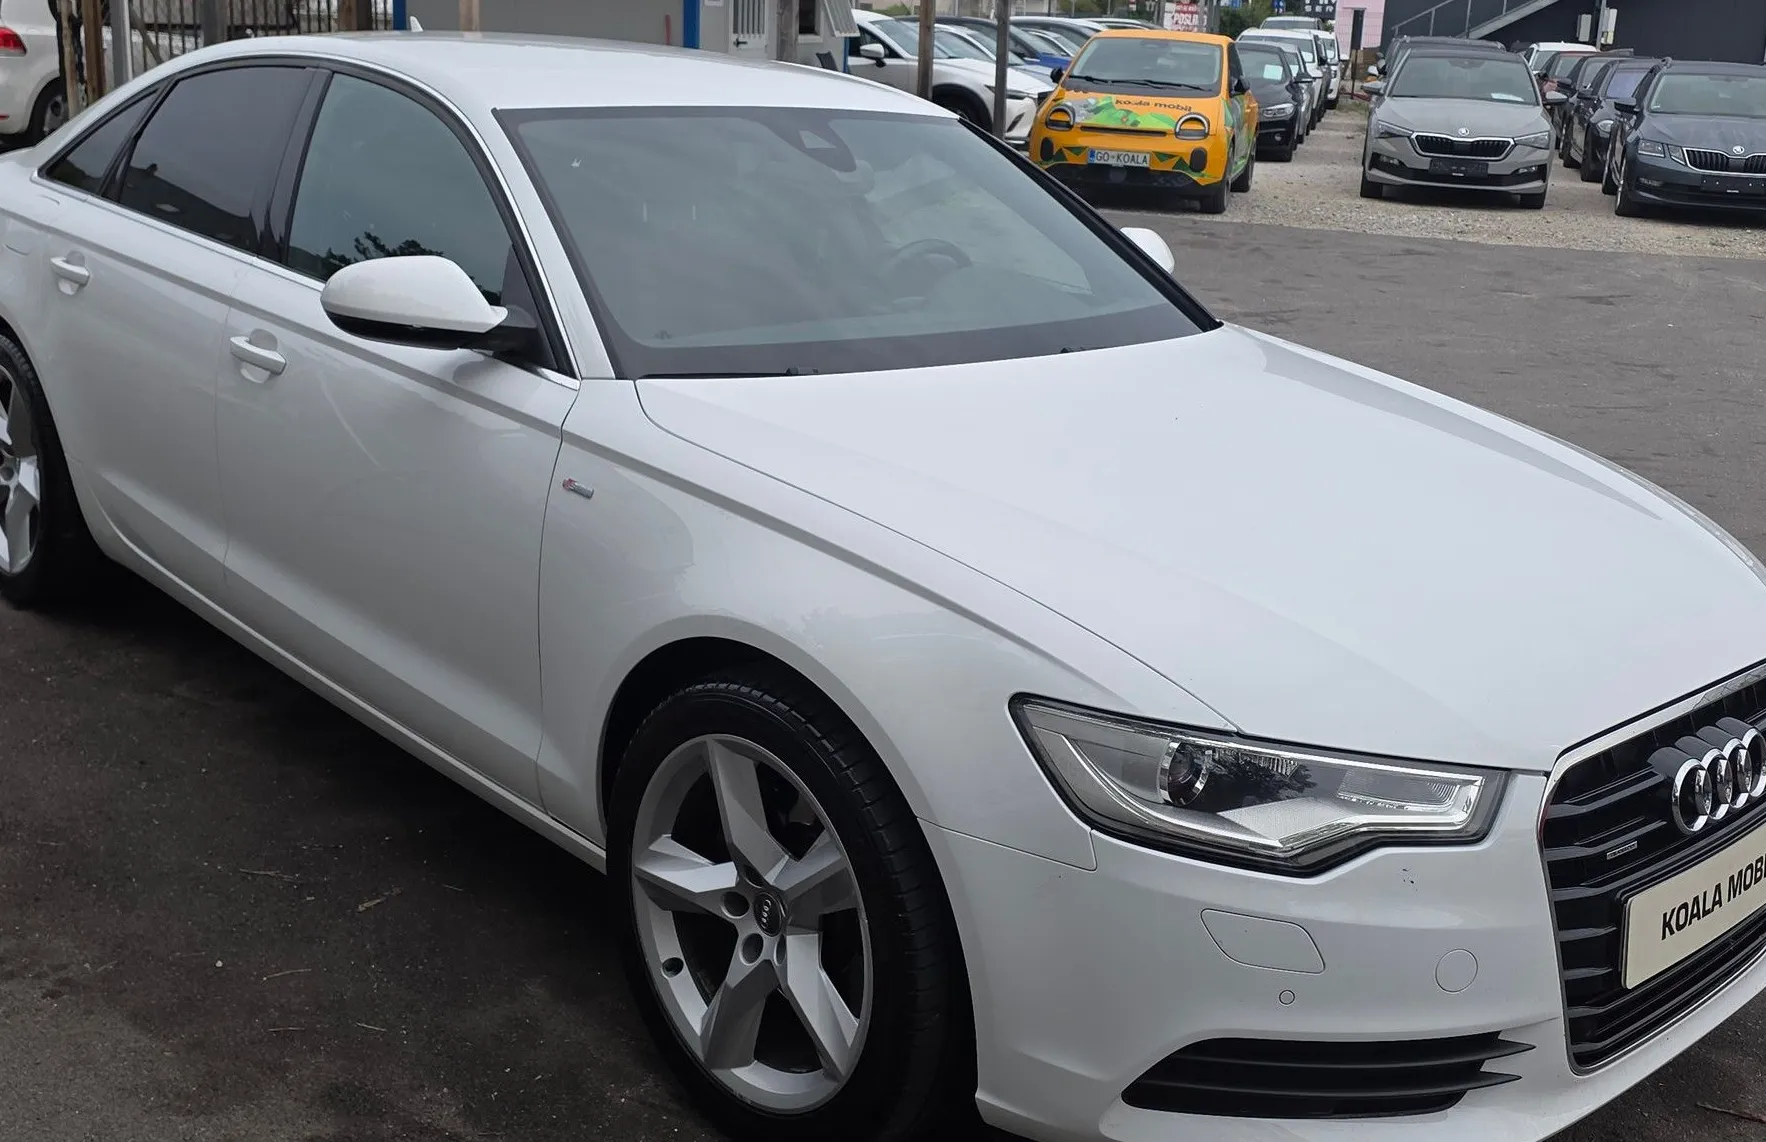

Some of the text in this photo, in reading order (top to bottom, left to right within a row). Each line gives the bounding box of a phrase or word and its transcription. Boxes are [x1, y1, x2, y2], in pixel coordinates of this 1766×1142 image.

[1154, 101, 1192, 112] mobil
[1116, 153, 1148, 165] KOALA
[1661, 882, 1723, 941] KOALA
